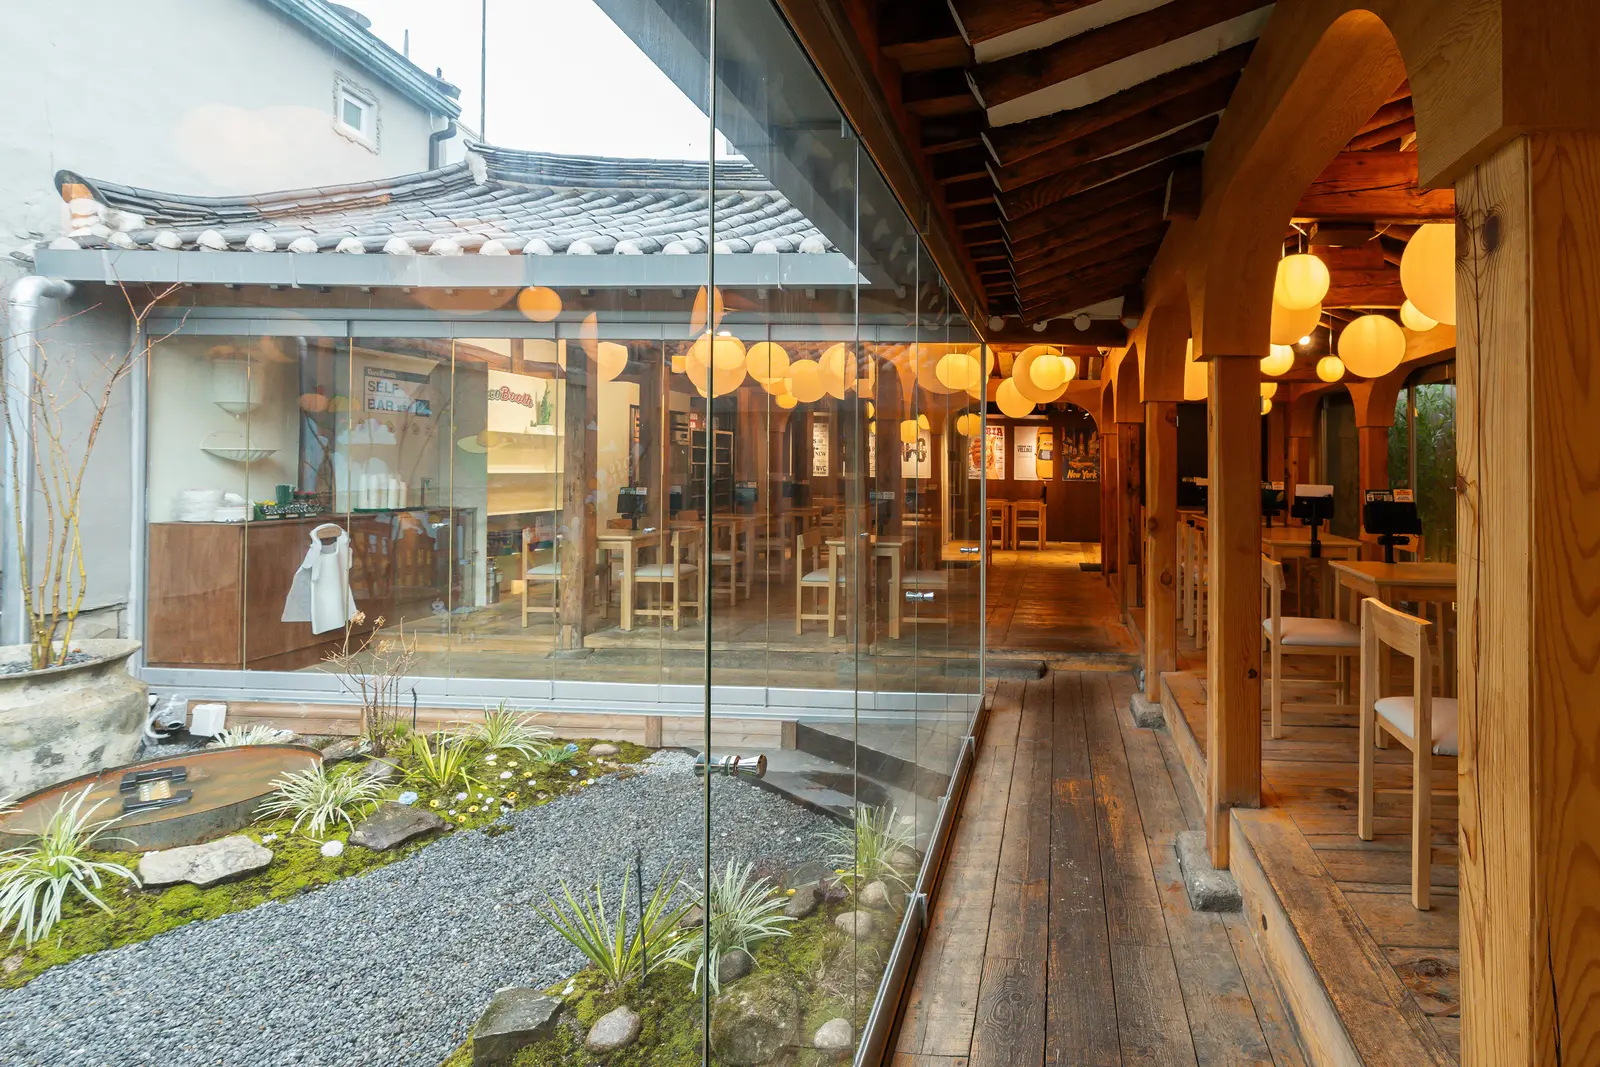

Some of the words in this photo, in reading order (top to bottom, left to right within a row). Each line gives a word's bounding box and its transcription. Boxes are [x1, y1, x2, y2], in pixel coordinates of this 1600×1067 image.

[367, 380, 399, 394] SELF
[488, 386, 534, 408] coBooth
[367, 398, 394, 411] BAR
[1067, 469, 1081, 479] New
[1082, 469, 1097, 480] York
